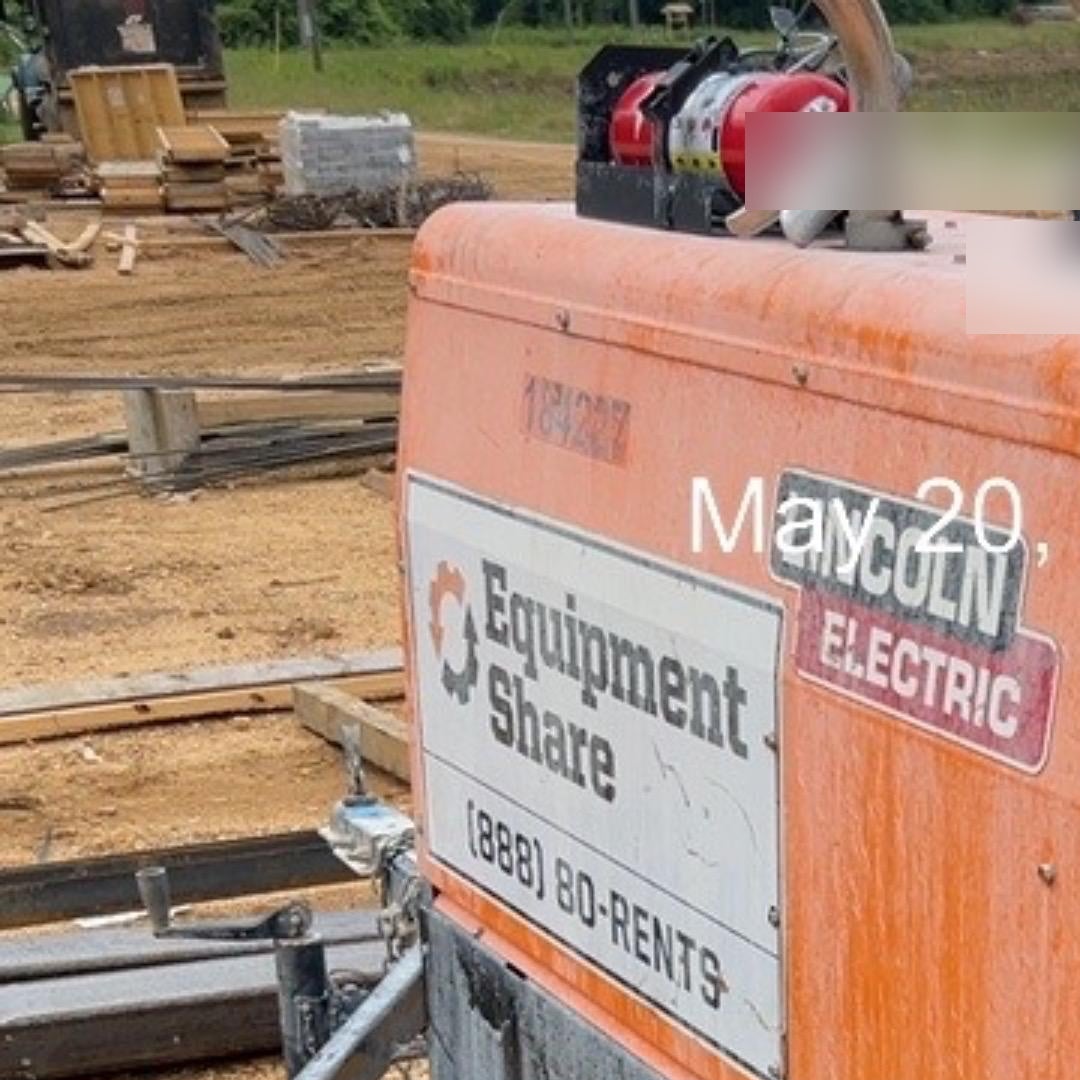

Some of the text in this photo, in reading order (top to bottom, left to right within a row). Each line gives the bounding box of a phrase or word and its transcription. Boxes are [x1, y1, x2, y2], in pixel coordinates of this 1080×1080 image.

[482, 559, 749, 760] Equipment
[487, 663, 616, 804] Share
[820, 609, 1022, 740] ELECTRIC
[467, 798, 725, 1010] (888) 80-RENTS
